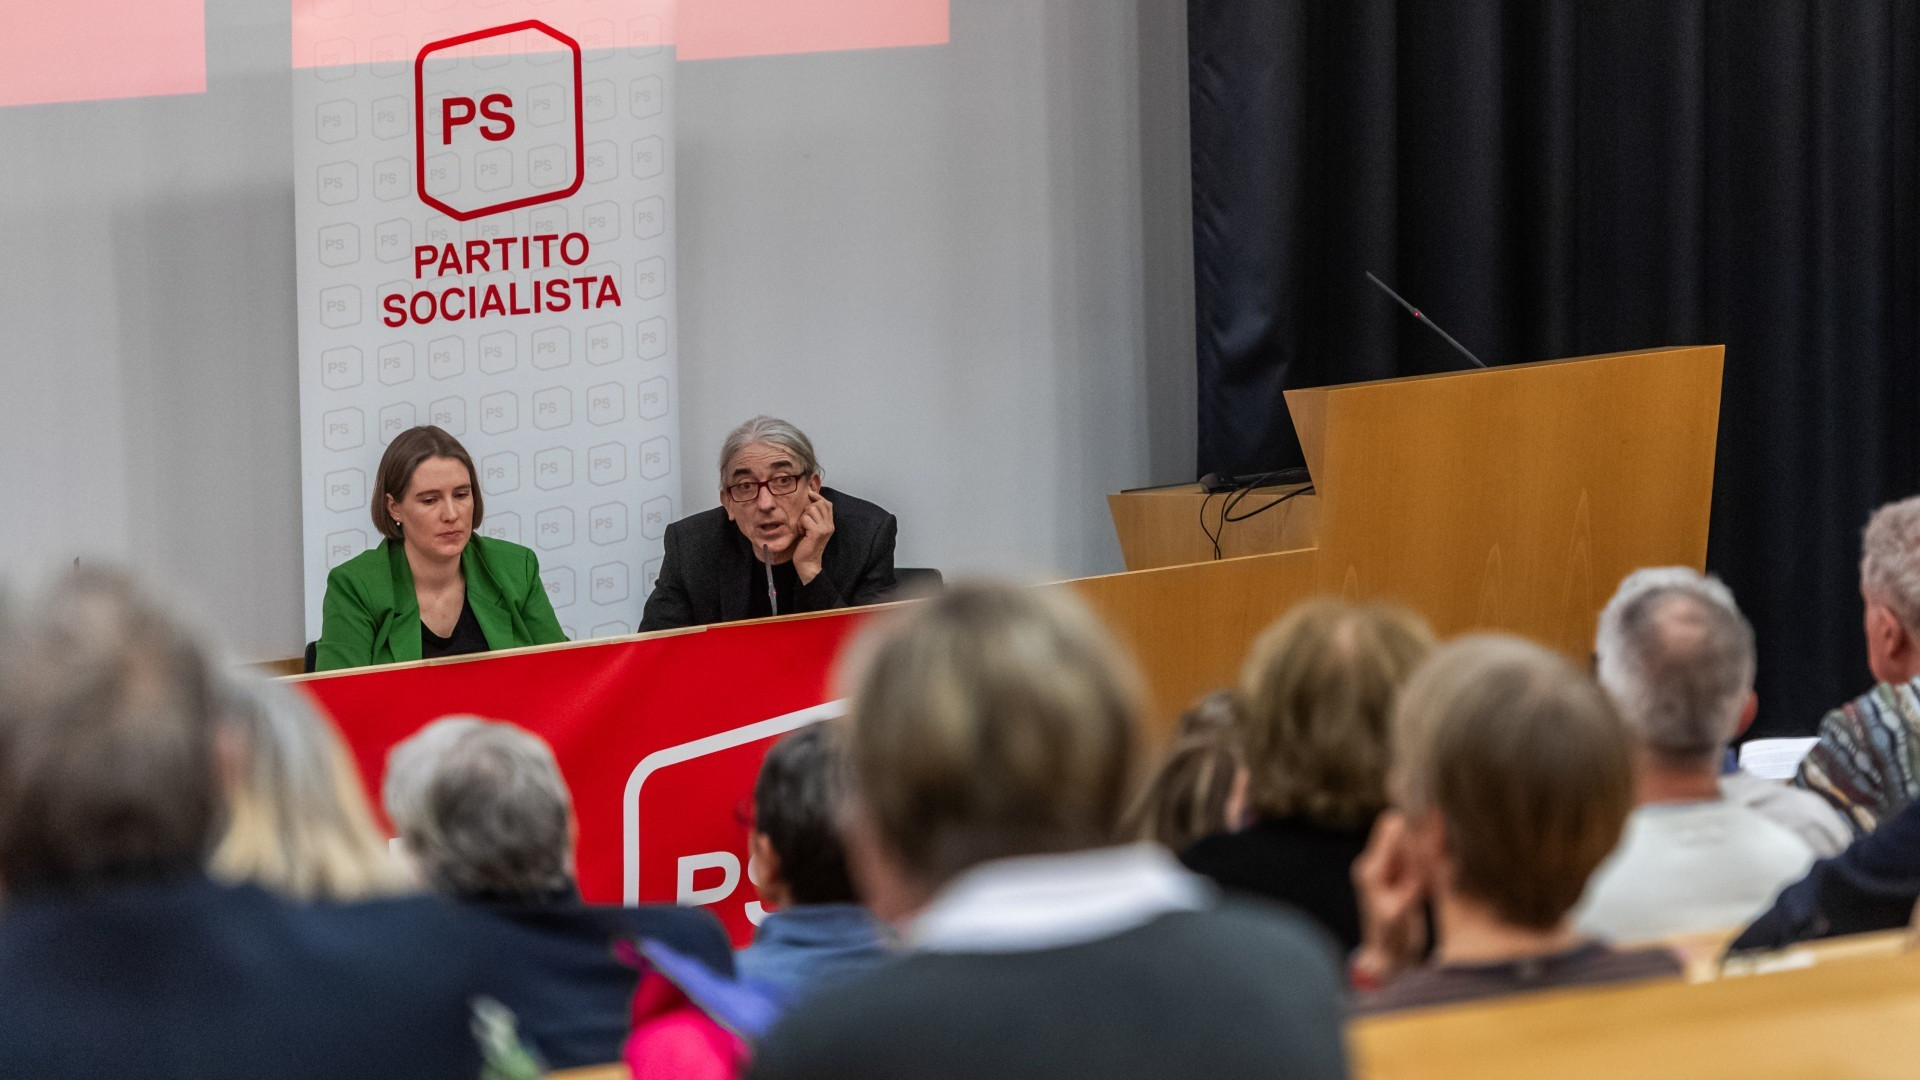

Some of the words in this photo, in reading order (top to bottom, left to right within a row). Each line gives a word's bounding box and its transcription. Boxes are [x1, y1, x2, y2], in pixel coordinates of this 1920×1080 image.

[585, 95, 602, 107] PS
[634, 90, 650, 103] PS
[533, 99, 550, 111] PS
[322, 115, 341, 127] PS
[377, 111, 395, 124] PS
[442, 93, 515, 145] PS
[587, 155, 605, 168] PS
[636, 151, 653, 164] PS
[480, 163, 498, 176] PS
[534, 159, 553, 172] PS
[379, 172, 397, 185] PS
[430, 168, 447, 180] PS
[323, 177, 343, 189] PS
[588, 216, 606, 228] PS
[638, 211, 654, 223] PS
[482, 224, 500, 236] PS
[535, 220, 554, 232] PS
[381, 234, 399, 246] PS
[431, 229, 448, 241] PS
[325, 238, 345, 250] PS
[415, 232, 590, 279] PARTITO
[640, 272, 655, 284] PS
[326, 300, 346, 313] PS
[383, 275, 622, 328] SOCIALISTA
[591, 337, 609, 350] PS
[641, 332, 657, 344] PS
[484, 346, 502, 358] PS
[537, 342, 556, 354] PS
[384, 357, 401, 369] PS
[433, 351, 450, 363] PS
[328, 362, 348, 374] PS
[592, 397, 611, 410] PS
[643, 392, 659, 404] PS
[486, 407, 504, 419] PS
[539, 402, 557, 414] PS
[384, 418, 402, 430] PS
[434, 412, 452, 424] PS
[329, 423, 349, 435] PS
[594, 458, 612, 470] PS
[645, 452, 660, 464] PS
[487, 467, 505, 479] PS
[540, 462, 559, 474] PS
[331, 484, 350, 496] PS
[595, 517, 614, 529] PS
[646, 512, 662, 524] PS
[541, 522, 560, 534] PS
[332, 545, 352, 557] PS
[596, 577, 614, 589] PS
